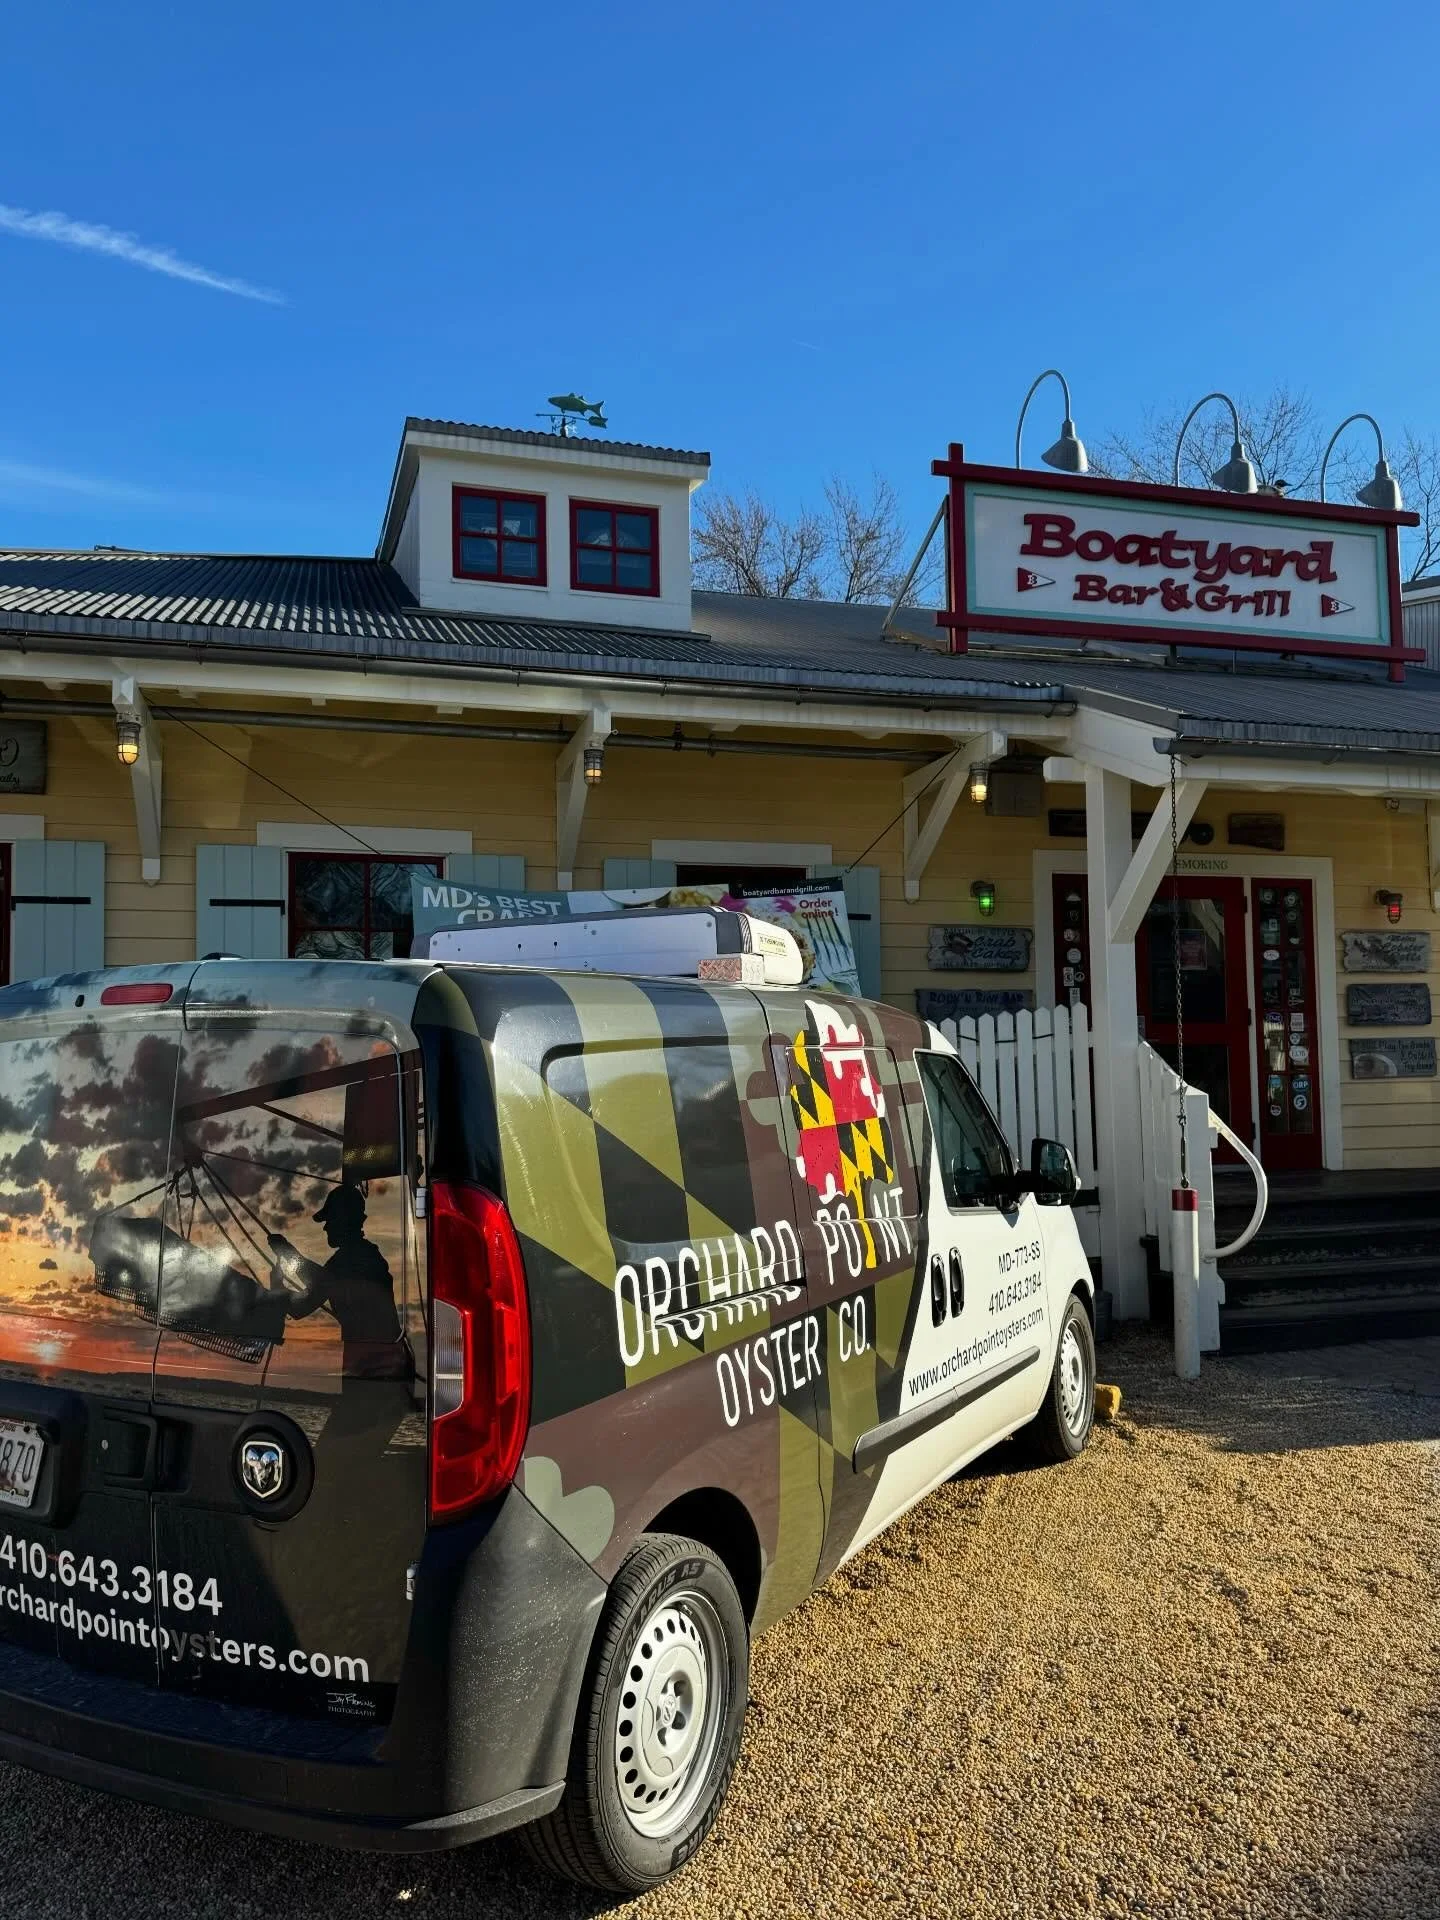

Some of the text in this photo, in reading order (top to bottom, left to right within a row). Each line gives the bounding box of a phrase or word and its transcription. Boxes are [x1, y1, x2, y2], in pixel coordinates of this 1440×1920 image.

[1019, 513, 1338, 584] Boatyard
[422, 886, 561, 916] MD's BEST
[743, 885, 830, 897] boatyardbarandgrill.com
[799, 898, 833, 909] Order
[801, 907, 839, 919] online!
[998, 1240, 1041, 1275] MD-773-SS
[614, 1219, 804, 1367] ORCHARD
[988, 1271, 1042, 1316] 410.643.3184
[716, 1295, 871, 1428] OYSTER CO.
[909, 1307, 1044, 1396] www.orchardpointoysters.com
[0, 1438, 36, 1483] 870
[0, 1534, 223, 1616] 410.643.3184
[0, 1584, 370, 1683] rchardpointoysters.com
